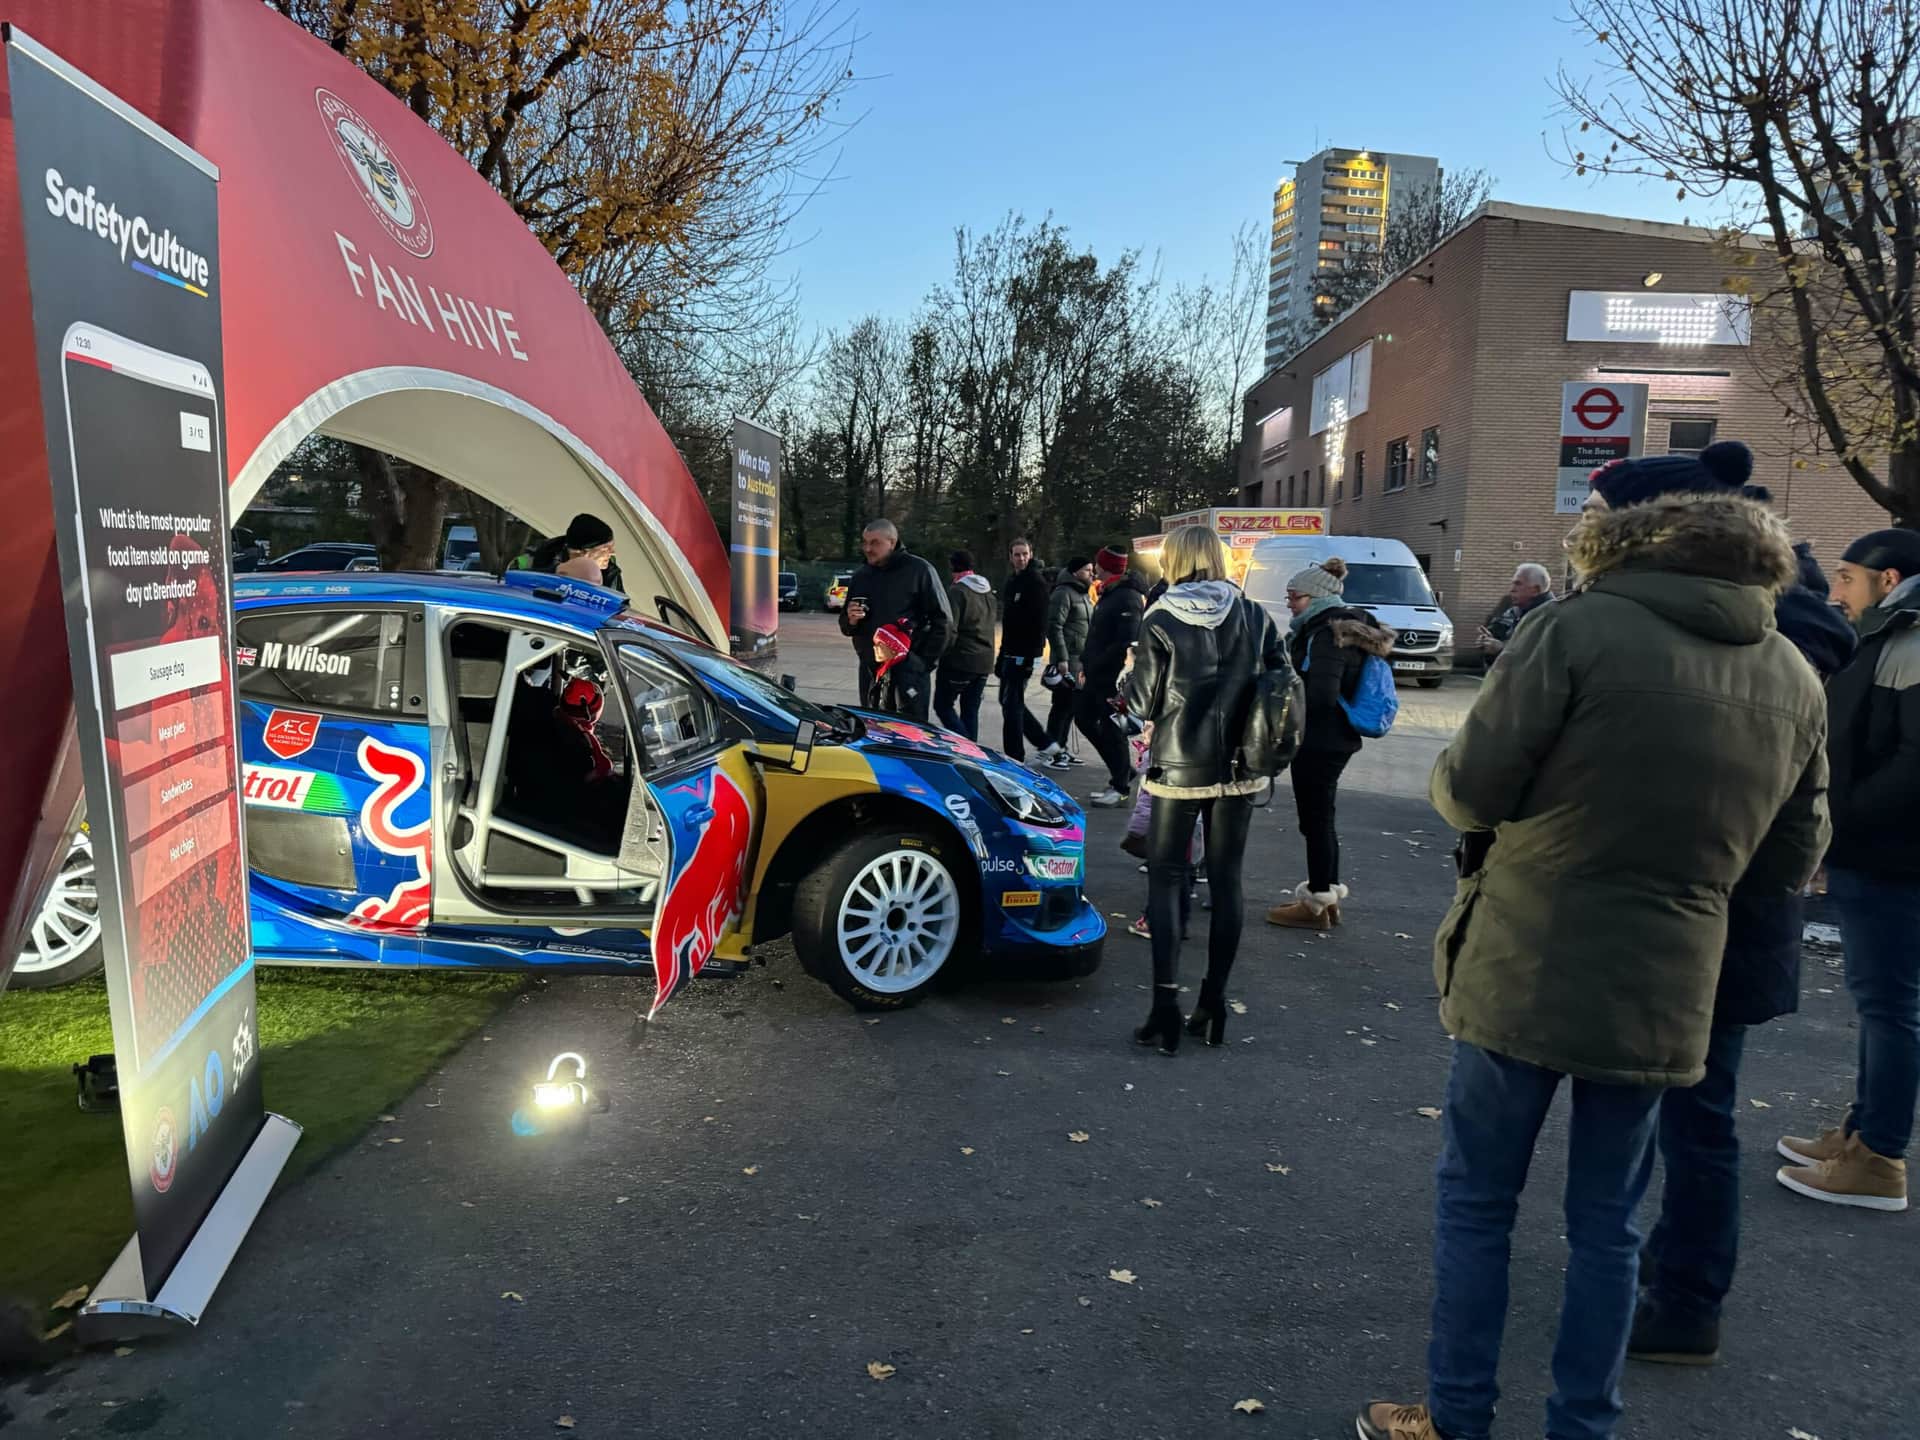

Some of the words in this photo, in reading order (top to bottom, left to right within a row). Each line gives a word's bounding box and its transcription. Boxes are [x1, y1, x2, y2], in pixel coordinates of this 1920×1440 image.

[46, 168, 208, 287] SafetyCulture
[334, 231, 435, 333] FAN
[428, 285, 528, 361] HIVE
[738, 448, 752, 468] Win
[752, 457, 758, 470] a
[758, 455, 771, 479] trip
[1577, 446, 1592, 455] The
[1594, 447, 1616, 456] Bees
[738, 472, 746, 489] to
[747, 475, 776, 498] Australia
[1564, 497, 1577, 506] 110
[99, 508, 127, 528] What
[127, 508, 135, 529] is
[136, 510, 150, 530] the
[151, 513, 173, 531] most
[174, 514, 211, 536] popular
[1218, 515, 1321, 531] SIZZLER
[108, 545, 130, 566] food
[130, 545, 149, 566] item
[150, 546, 167, 565] sold
[169, 549, 180, 565] on
[181, 549, 209, 570] game
[126, 583, 142, 608] day
[143, 583, 152, 600] at
[153, 579, 196, 600] Brentford?
[149, 665, 173, 680] Sausage
[173, 660, 185, 677] dog
[260, 642, 283, 669] M
[286, 644, 351, 676] Wilson
[158, 725, 174, 741] Meat
[174, 721, 186, 739] pies
[160, 778, 193, 804] Sandwiches
[243, 771, 302, 802] trol
[981, 856, 1016, 877] pulse
[1047, 857, 1076, 877] Castrol
